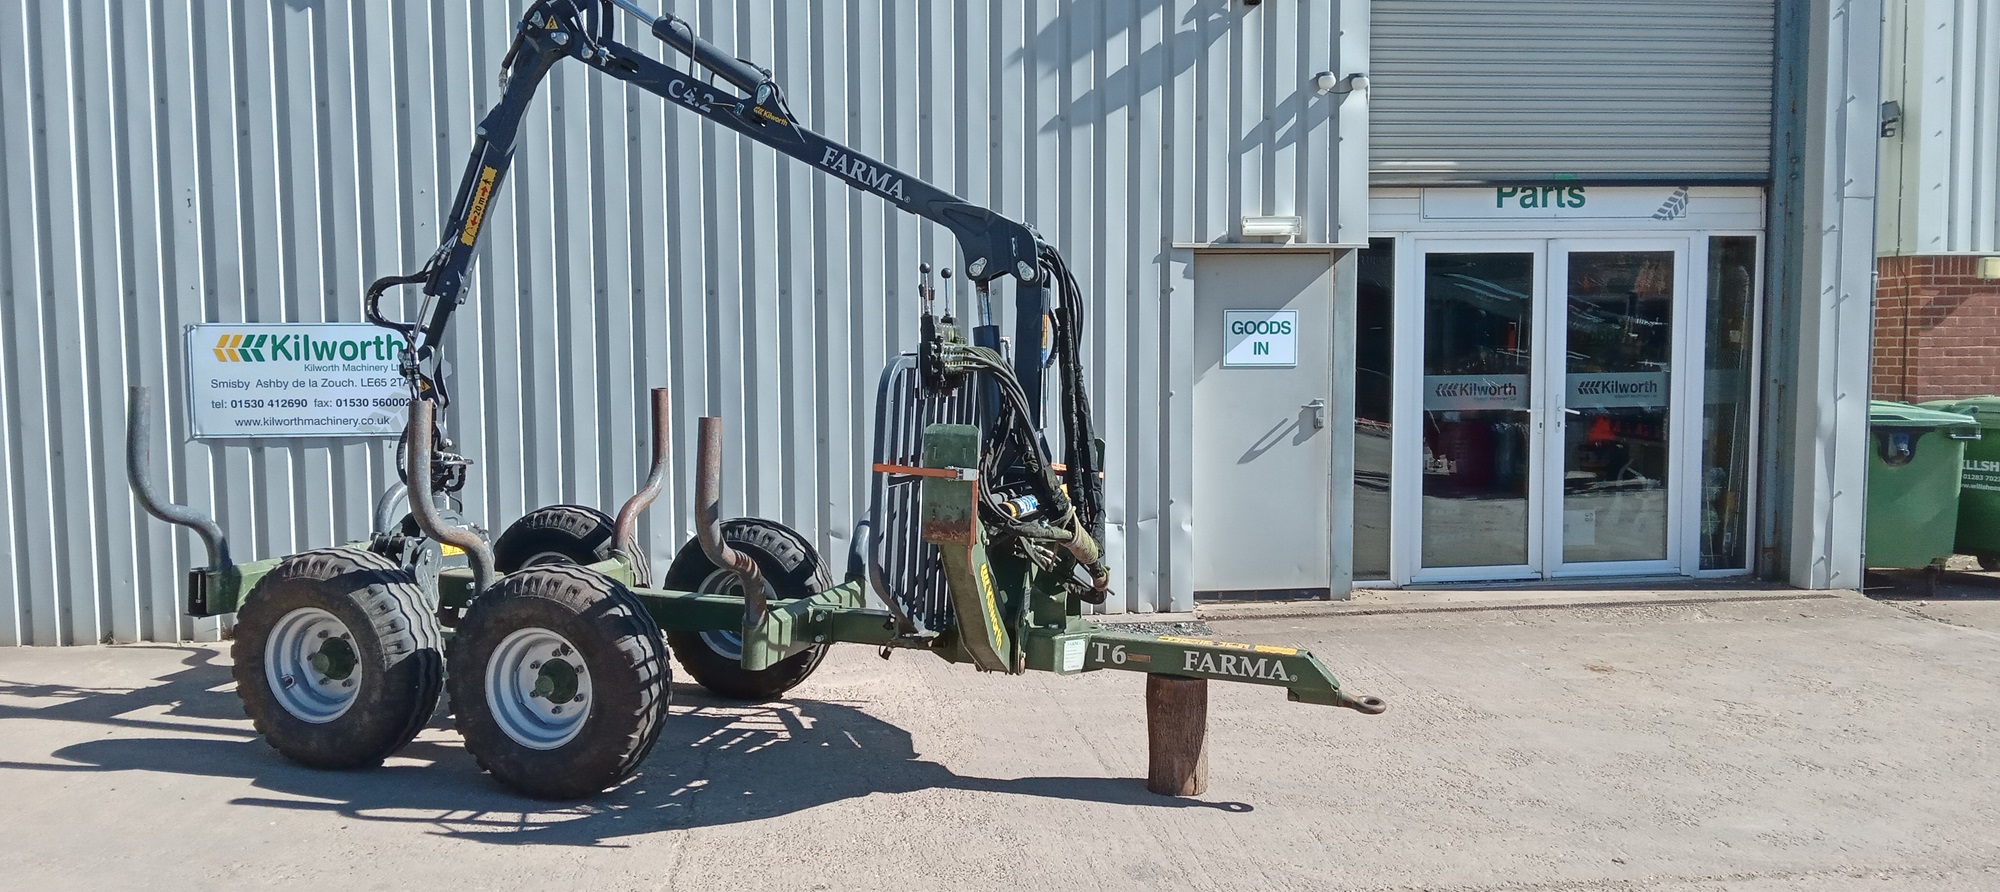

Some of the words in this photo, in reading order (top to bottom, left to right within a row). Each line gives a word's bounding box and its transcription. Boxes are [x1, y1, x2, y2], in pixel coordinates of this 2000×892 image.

[1496, 185, 1586, 209] Parts
[1231, 320, 1292, 335] GOODS
[271, 334, 404, 361] Kilworth
[1253, 341, 1269, 355] IN
[304, 363, 340, 372] Kilworth
[342, 363, 389, 373] Machinery
[210, 379, 251, 390] Smisby
[255, 379, 289, 390] Ashby
[292, 379, 306, 388] de
[308, 379, 318, 388] la
[320, 379, 358, 388] Zouch.
[360, 378, 388, 387] LE65
[1460, 382, 1517, 396] Kilworth
[1602, 380, 1658, 394] Kilworth
[211, 400, 228, 409] tel:
[230, 399, 265, 409] 01530
[267, 399, 308, 408] 412690
[314, 398, 333, 408] fax:
[335, 398, 370, 408] 01530
[234, 416, 390, 428] www.kilworthmachinery.co.uk
